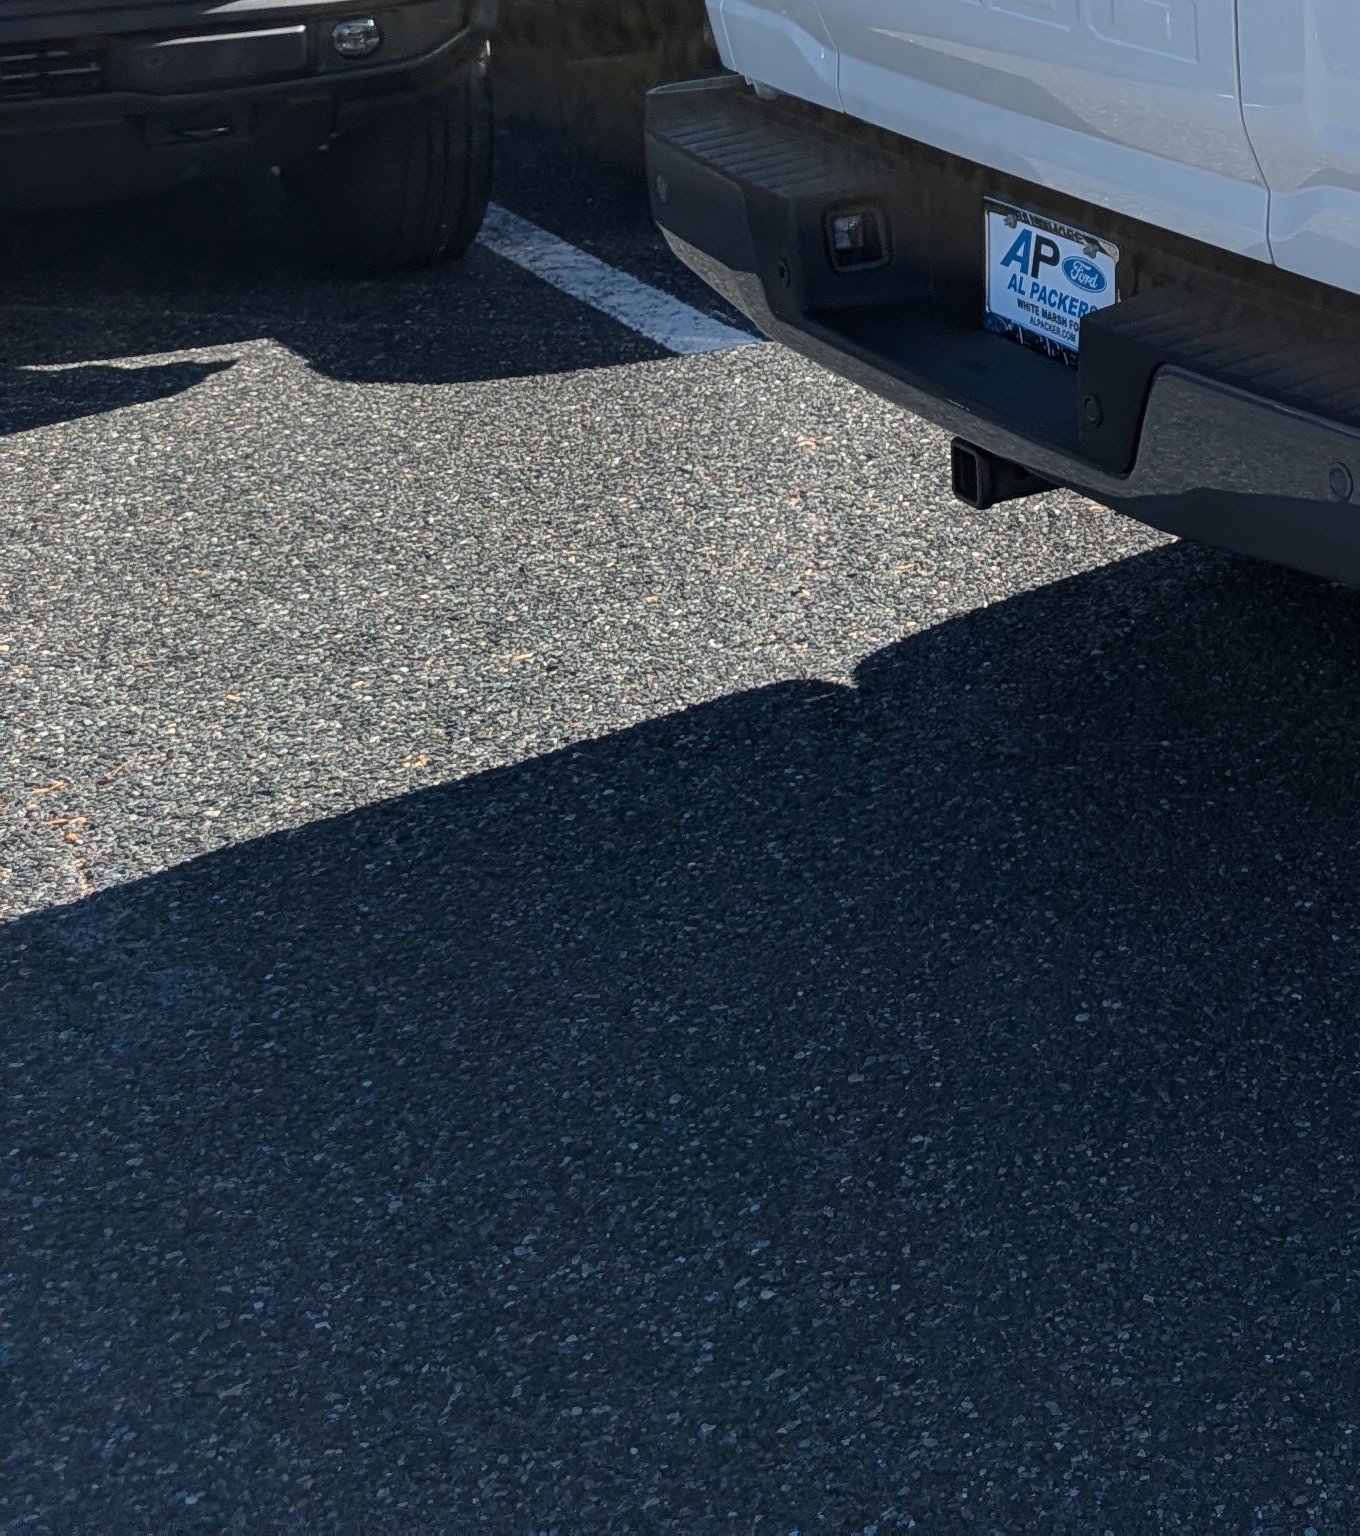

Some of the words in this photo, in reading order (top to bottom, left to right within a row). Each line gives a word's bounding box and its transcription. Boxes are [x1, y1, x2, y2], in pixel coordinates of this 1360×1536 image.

[1000, 228, 1061, 279] AP
[1007, 273, 1026, 296] AL
[1070, 261, 1099, 289] Ford
[1016, 298, 1041, 316] WHITE
[1041, 308, 1068, 327] MARSH
[1029, 316, 1076, 343] ALPACKER.COM
